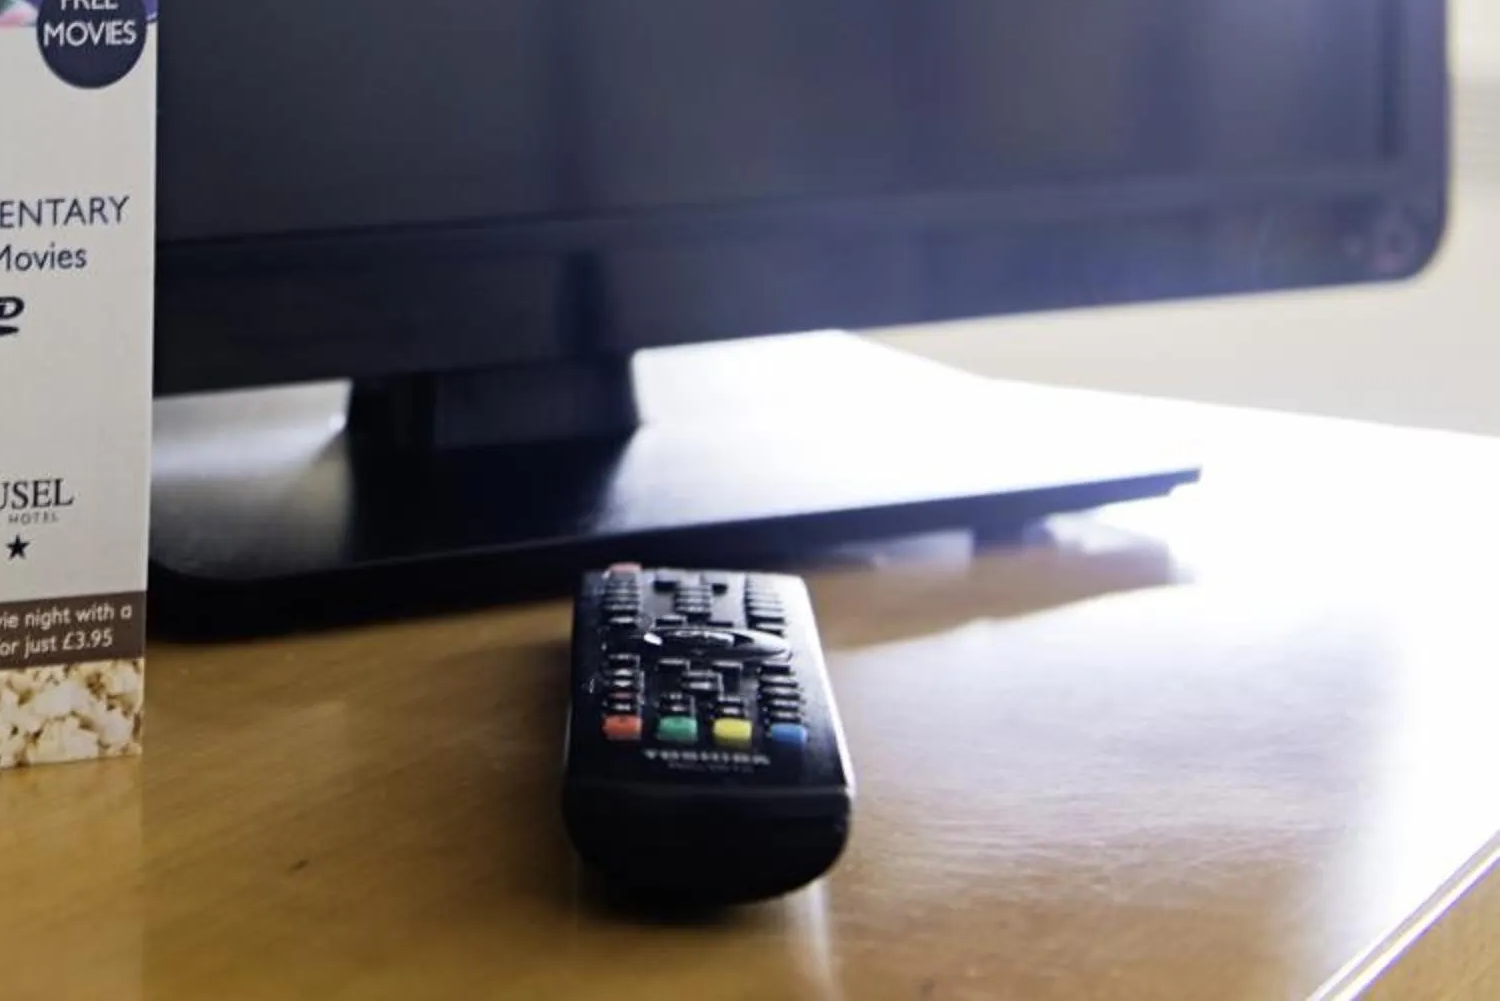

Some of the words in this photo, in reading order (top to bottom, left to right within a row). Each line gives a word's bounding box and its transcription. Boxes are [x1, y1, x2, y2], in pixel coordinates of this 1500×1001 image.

[42, 20, 138, 47] MOVIES
[7, 510, 60, 527] HOTEL
[24, 605, 72, 631] night
[75, 601, 116, 623] with
[120, 603, 133, 620] a
[23, 632, 59, 660] just
[62, 627, 114, 651] £3.95
